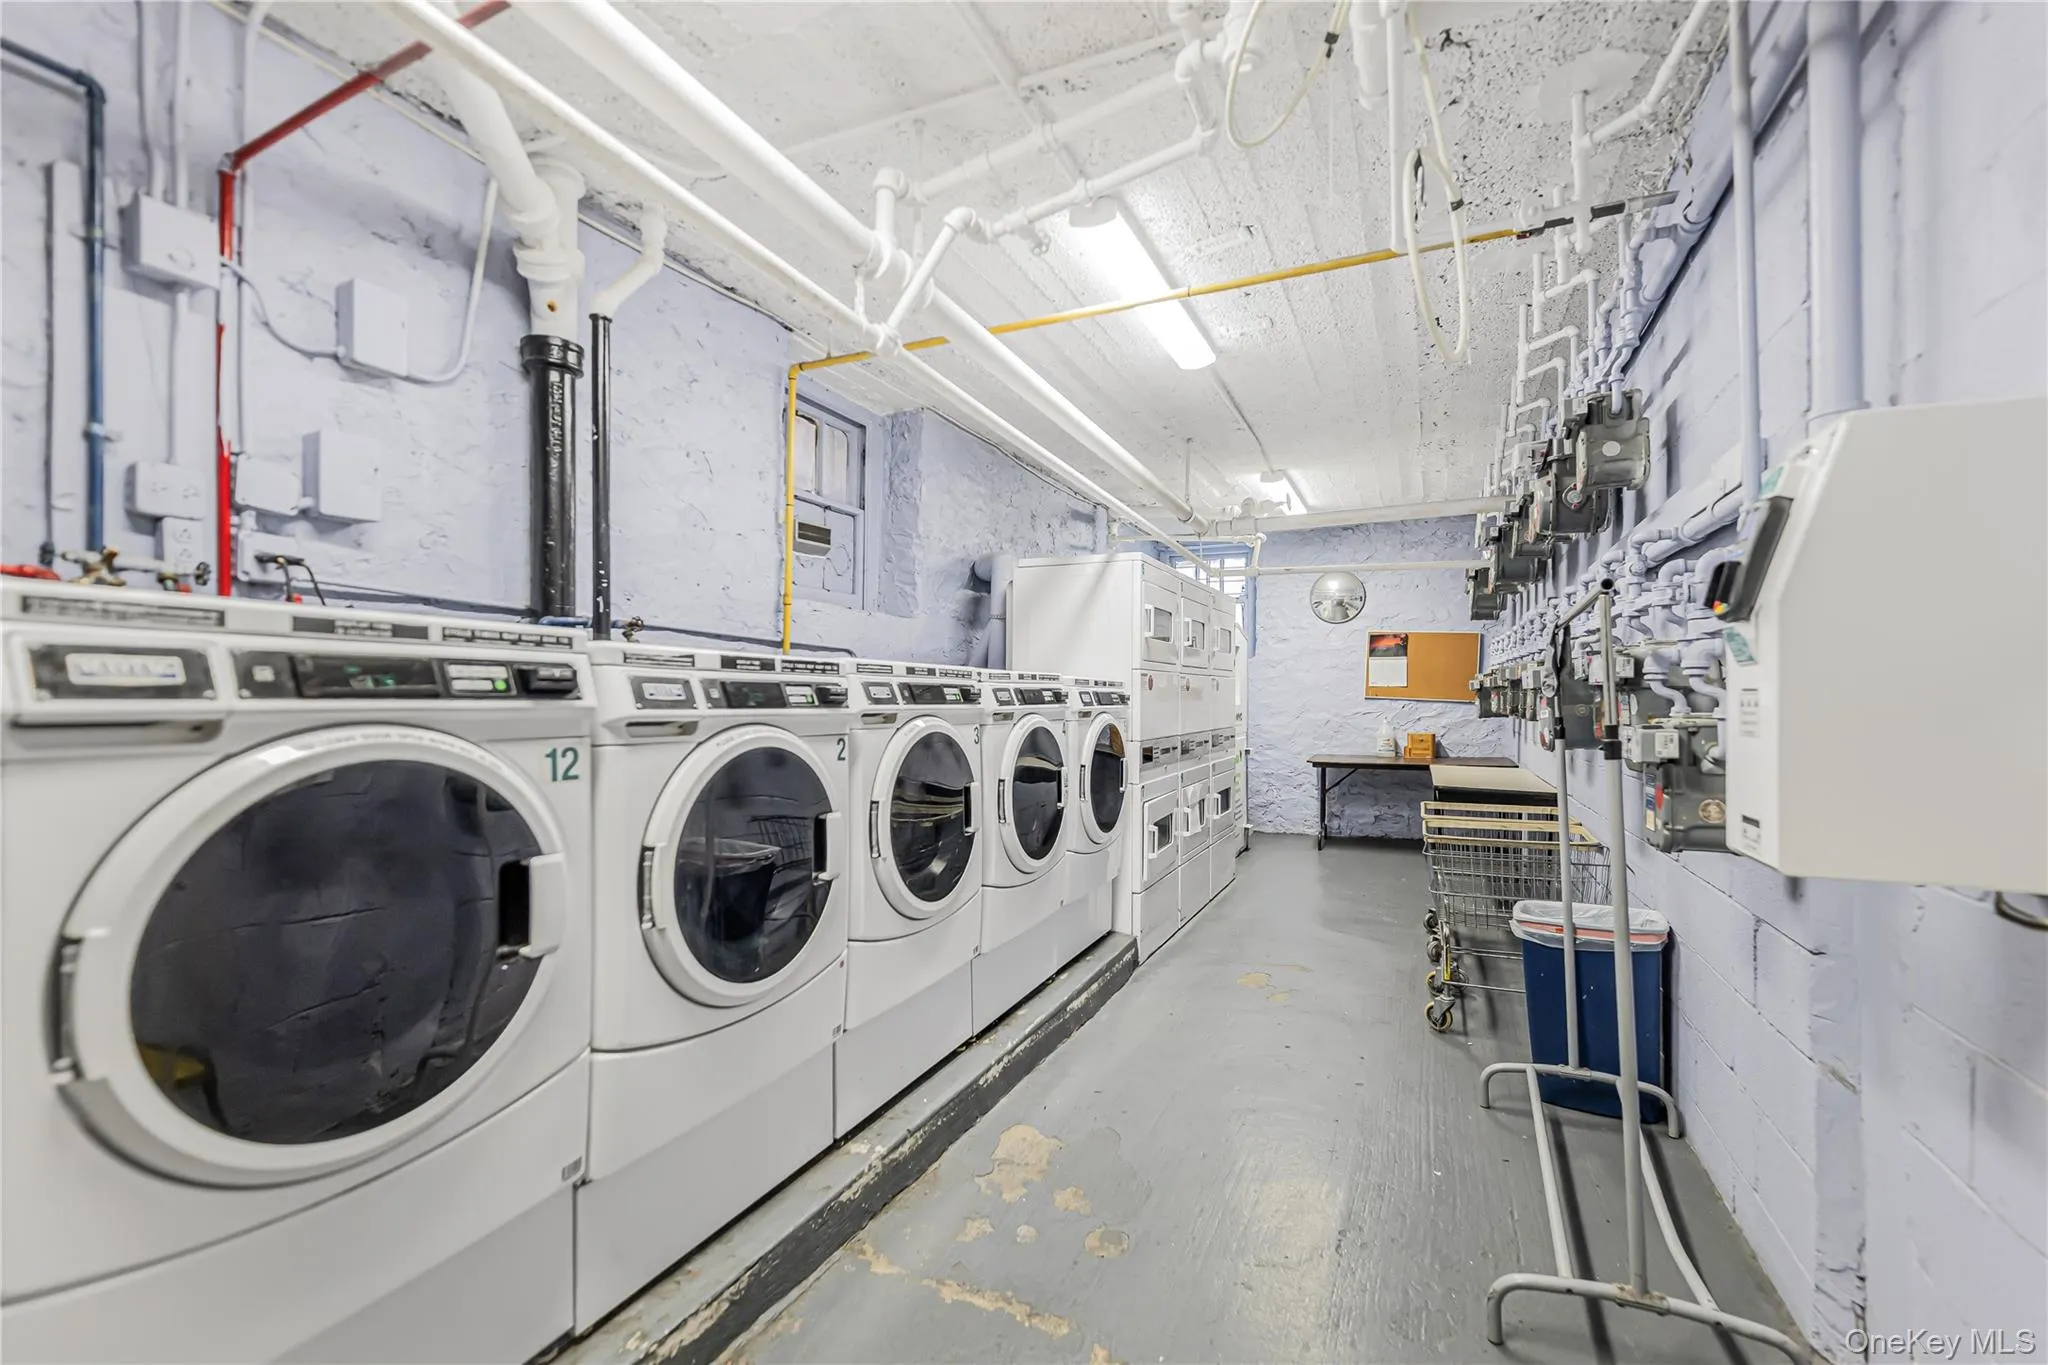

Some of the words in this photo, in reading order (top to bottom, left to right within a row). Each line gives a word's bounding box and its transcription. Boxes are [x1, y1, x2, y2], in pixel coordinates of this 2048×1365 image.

[973, 726, 979, 745] 3
[836, 738, 846, 761] 2
[545, 746, 579, 782] 12
